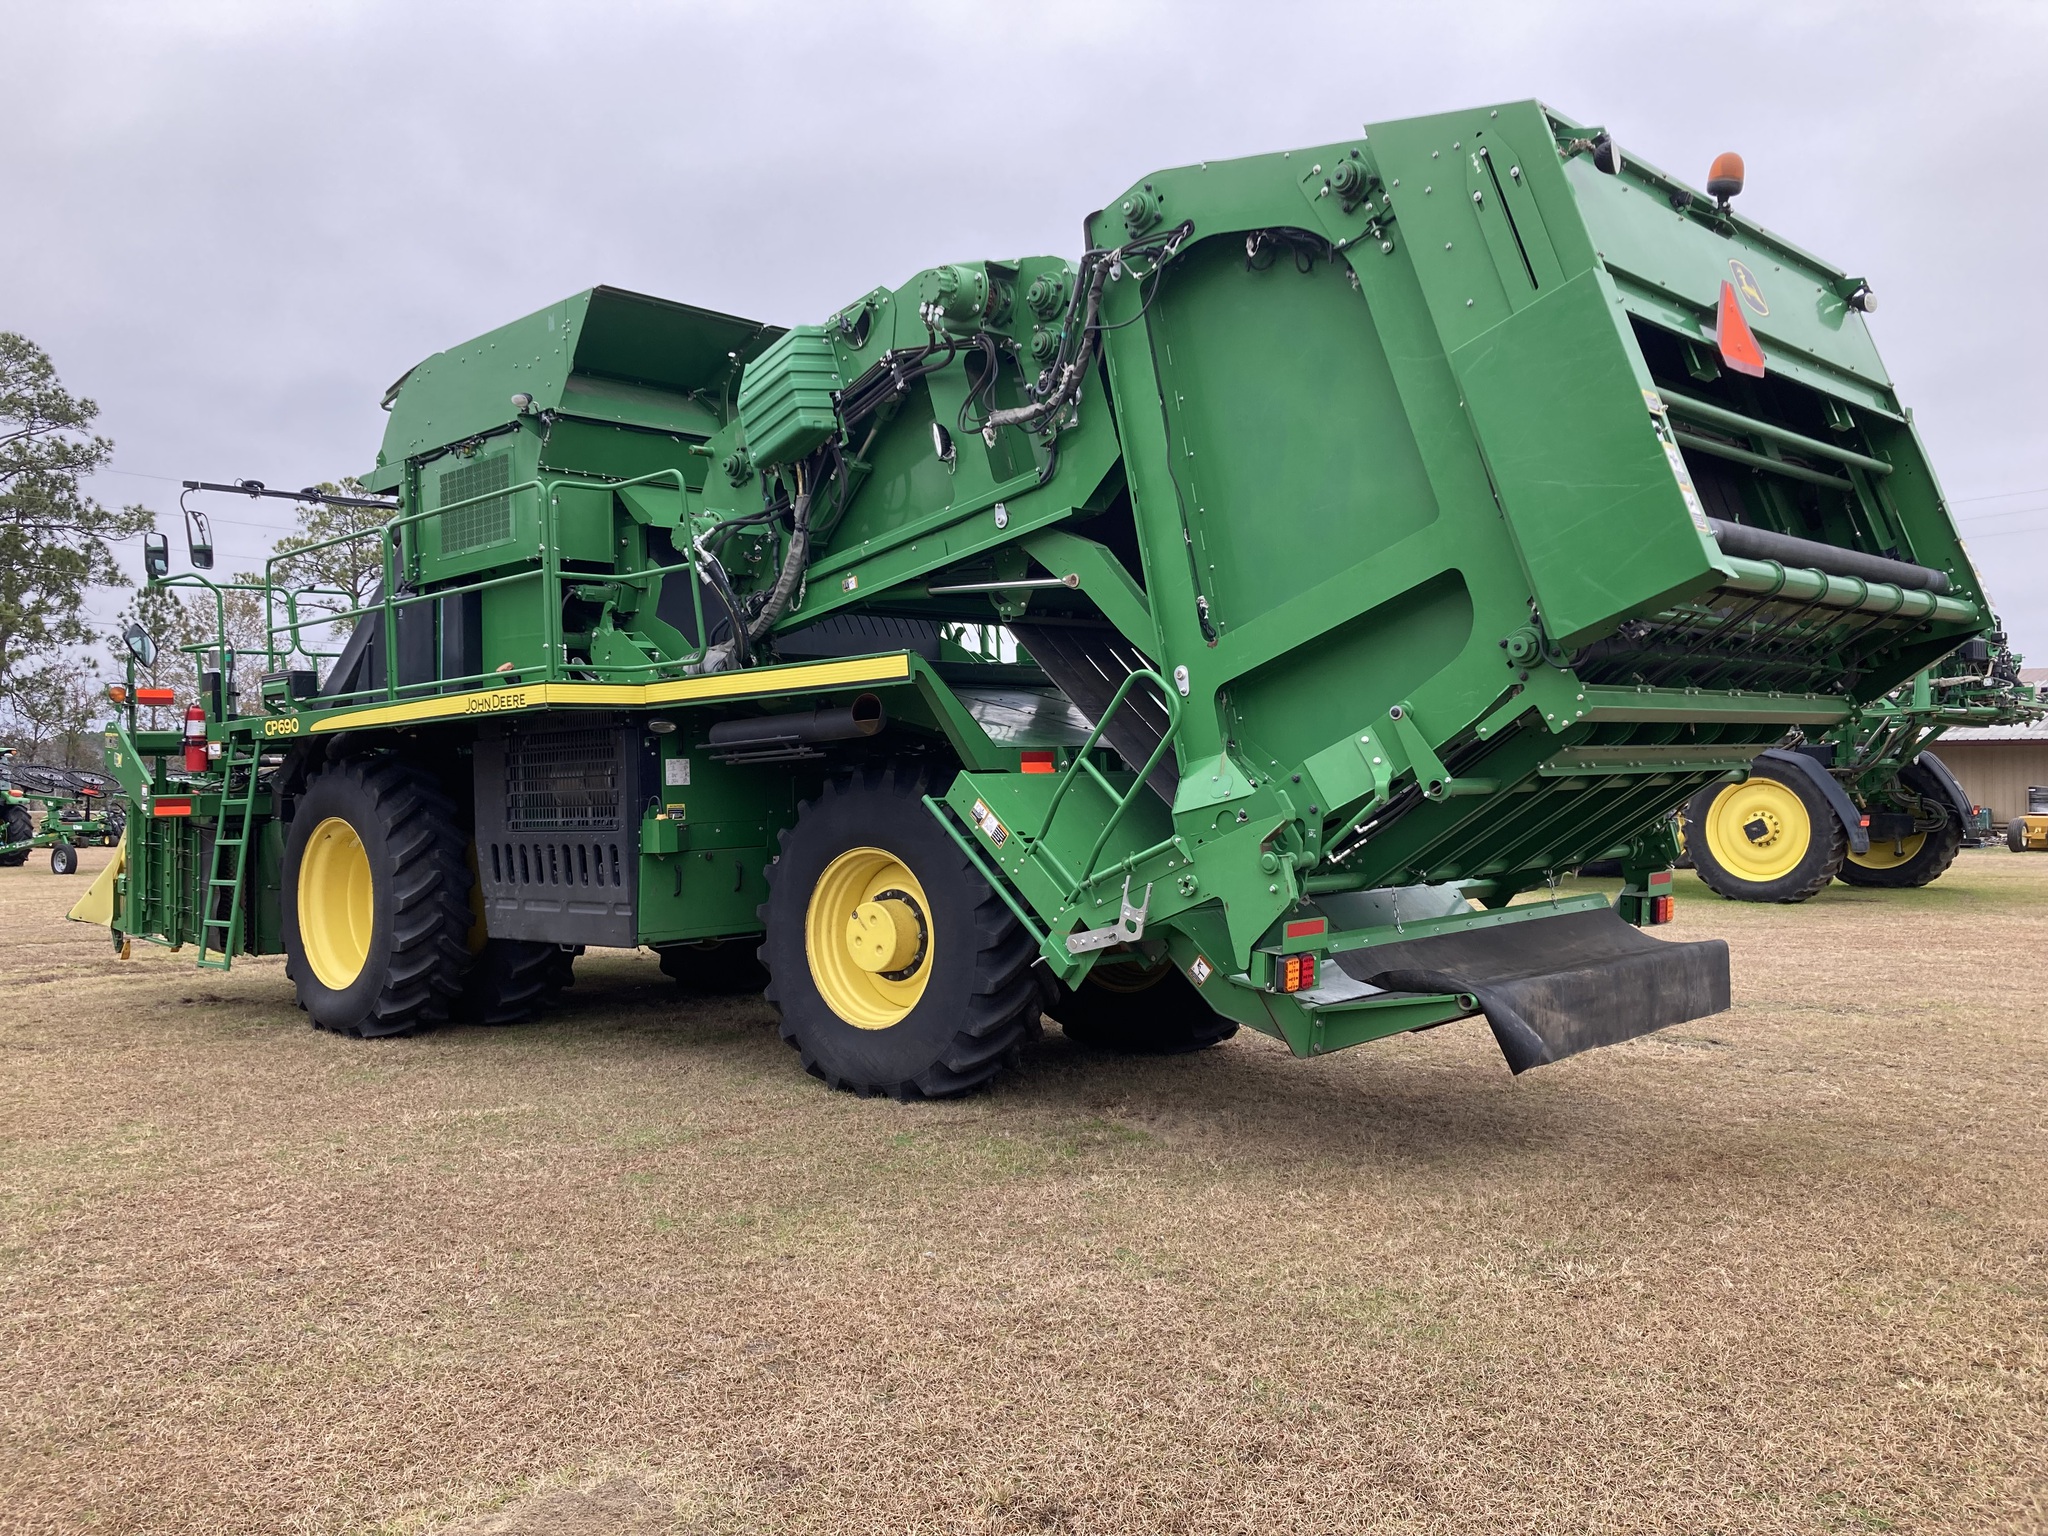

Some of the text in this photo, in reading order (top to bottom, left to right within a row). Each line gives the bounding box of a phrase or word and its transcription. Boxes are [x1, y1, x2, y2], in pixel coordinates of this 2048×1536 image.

[465, 693, 526, 712] JOHN DEERE
[264, 717, 299, 736] CP690
